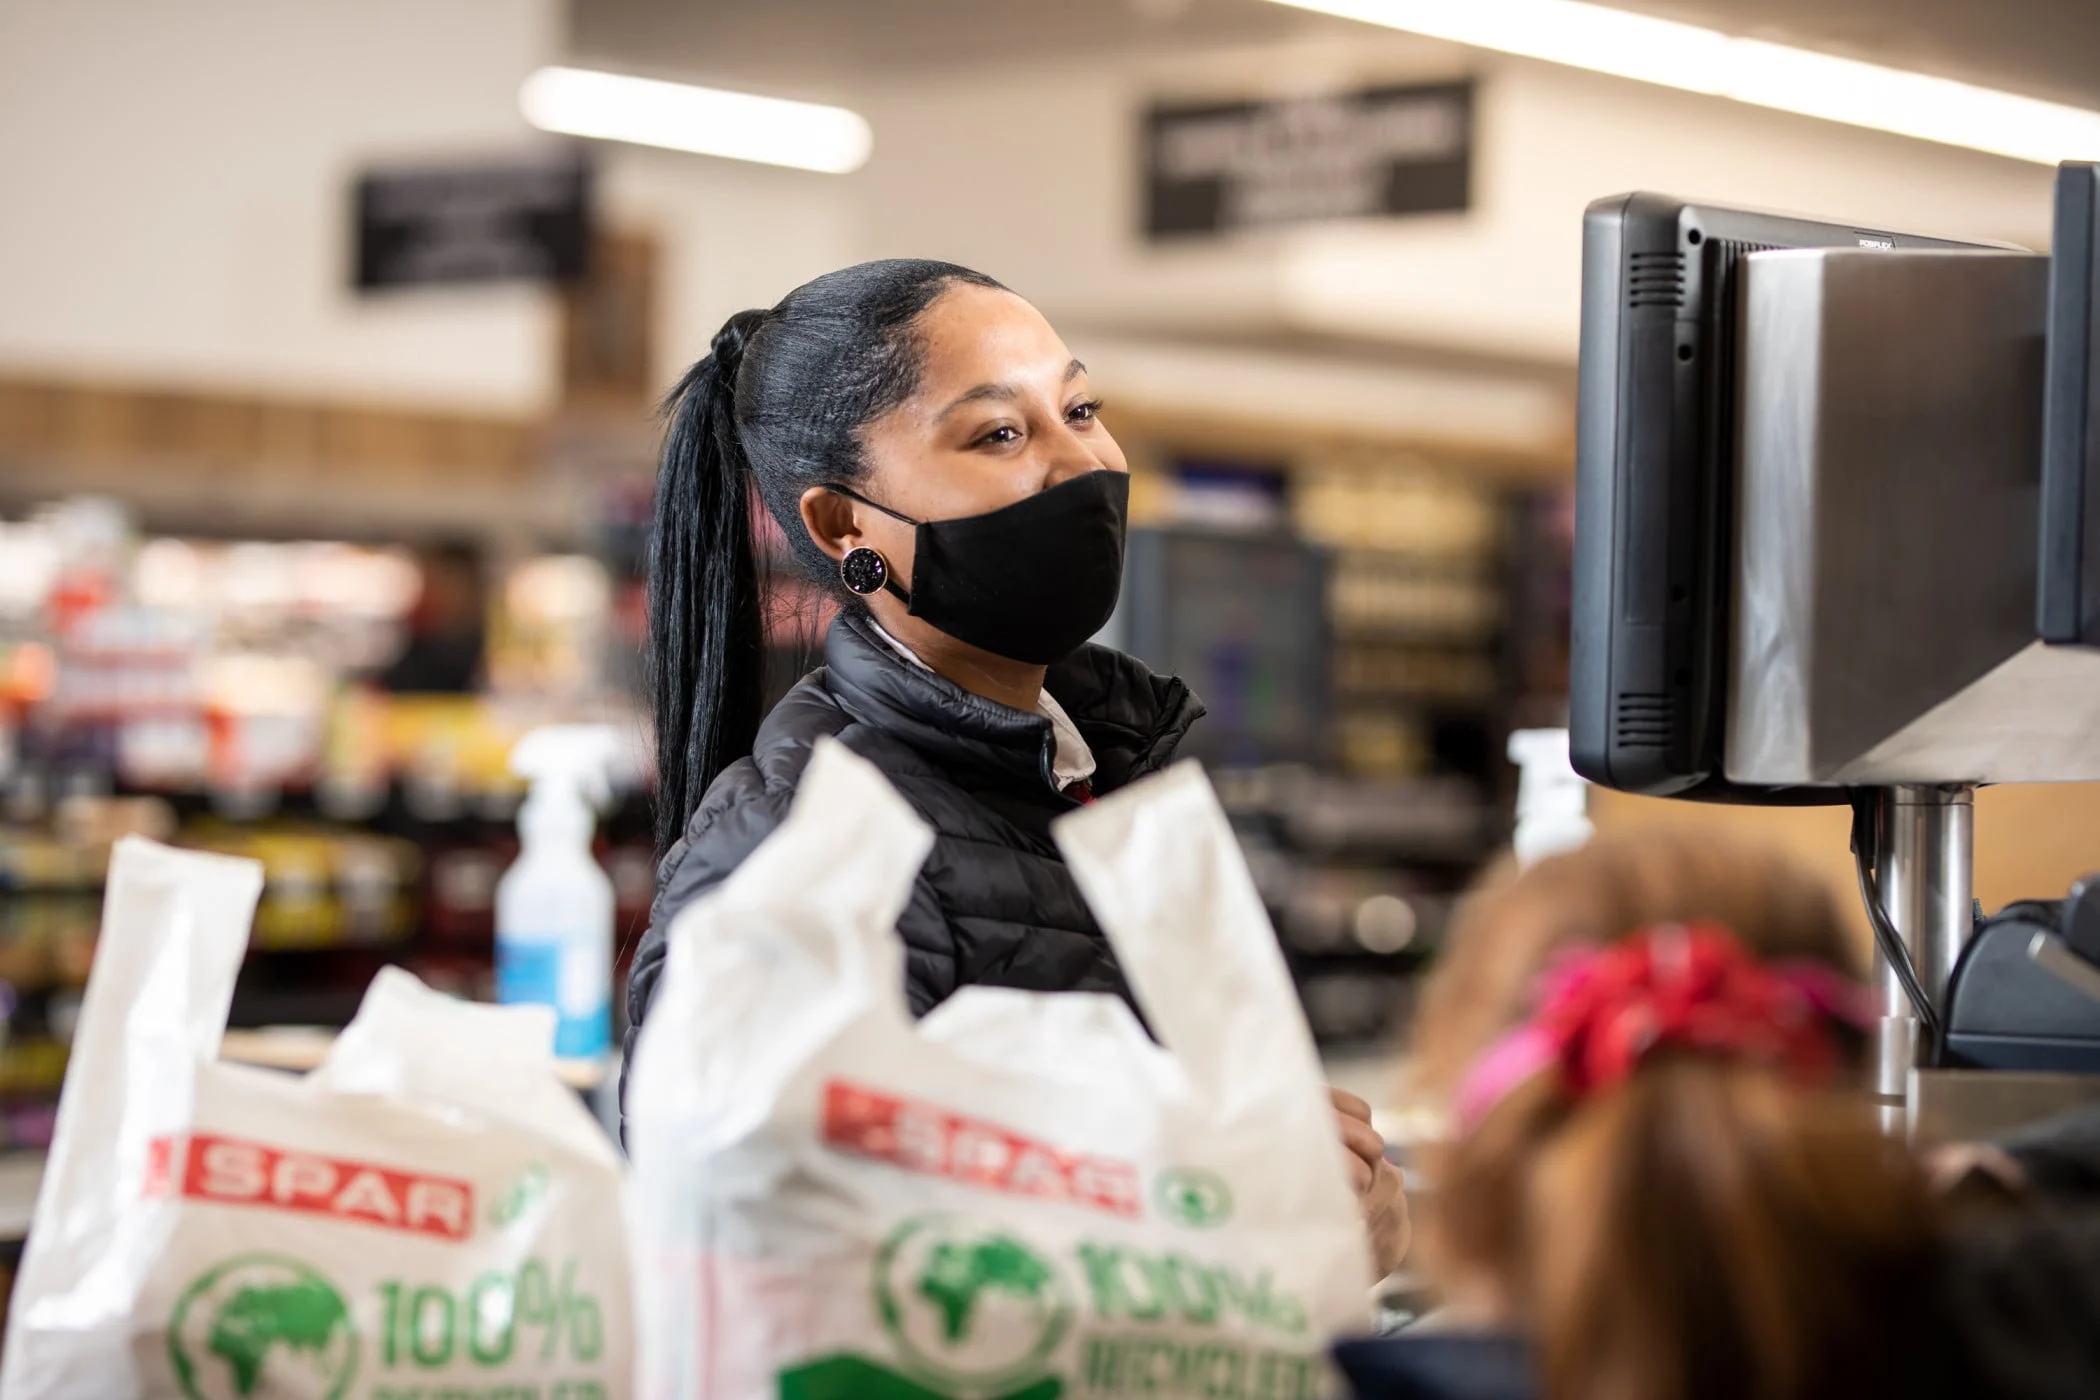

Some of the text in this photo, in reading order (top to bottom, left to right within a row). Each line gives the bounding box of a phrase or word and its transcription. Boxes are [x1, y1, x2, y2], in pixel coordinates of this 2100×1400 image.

[201, 1141, 464, 1235] SPAR
[896, 1099, 1139, 1217] SPAR
[375, 1256, 604, 1368] 100%
